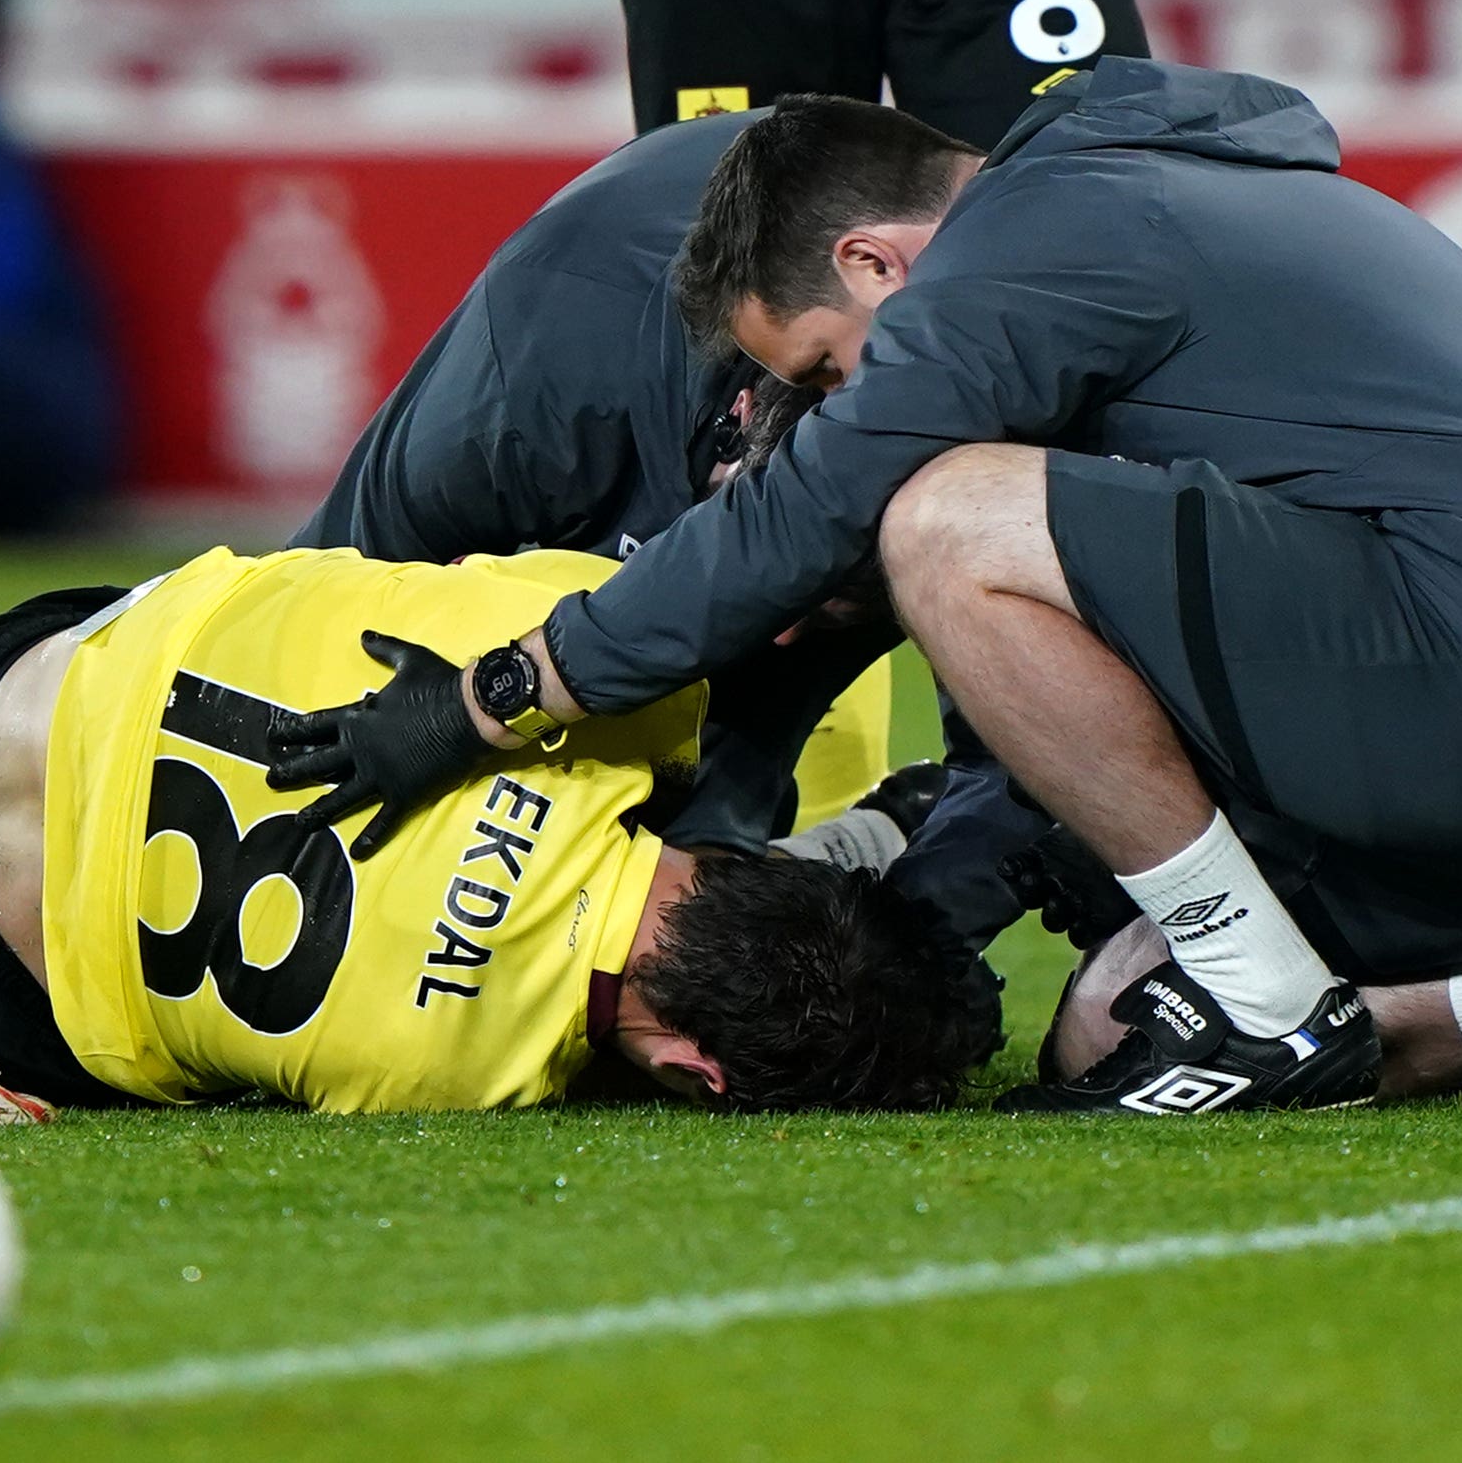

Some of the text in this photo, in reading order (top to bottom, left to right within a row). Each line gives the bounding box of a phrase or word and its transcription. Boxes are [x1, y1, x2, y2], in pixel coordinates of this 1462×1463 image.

[492, 672, 514, 693] 60
[414, 773, 554, 1010] EKDAL
[1174, 907, 1250, 943] umbro
[1143, 979, 1208, 1032] UMBRO
[1153, 1001, 1195, 1042] Speciali
